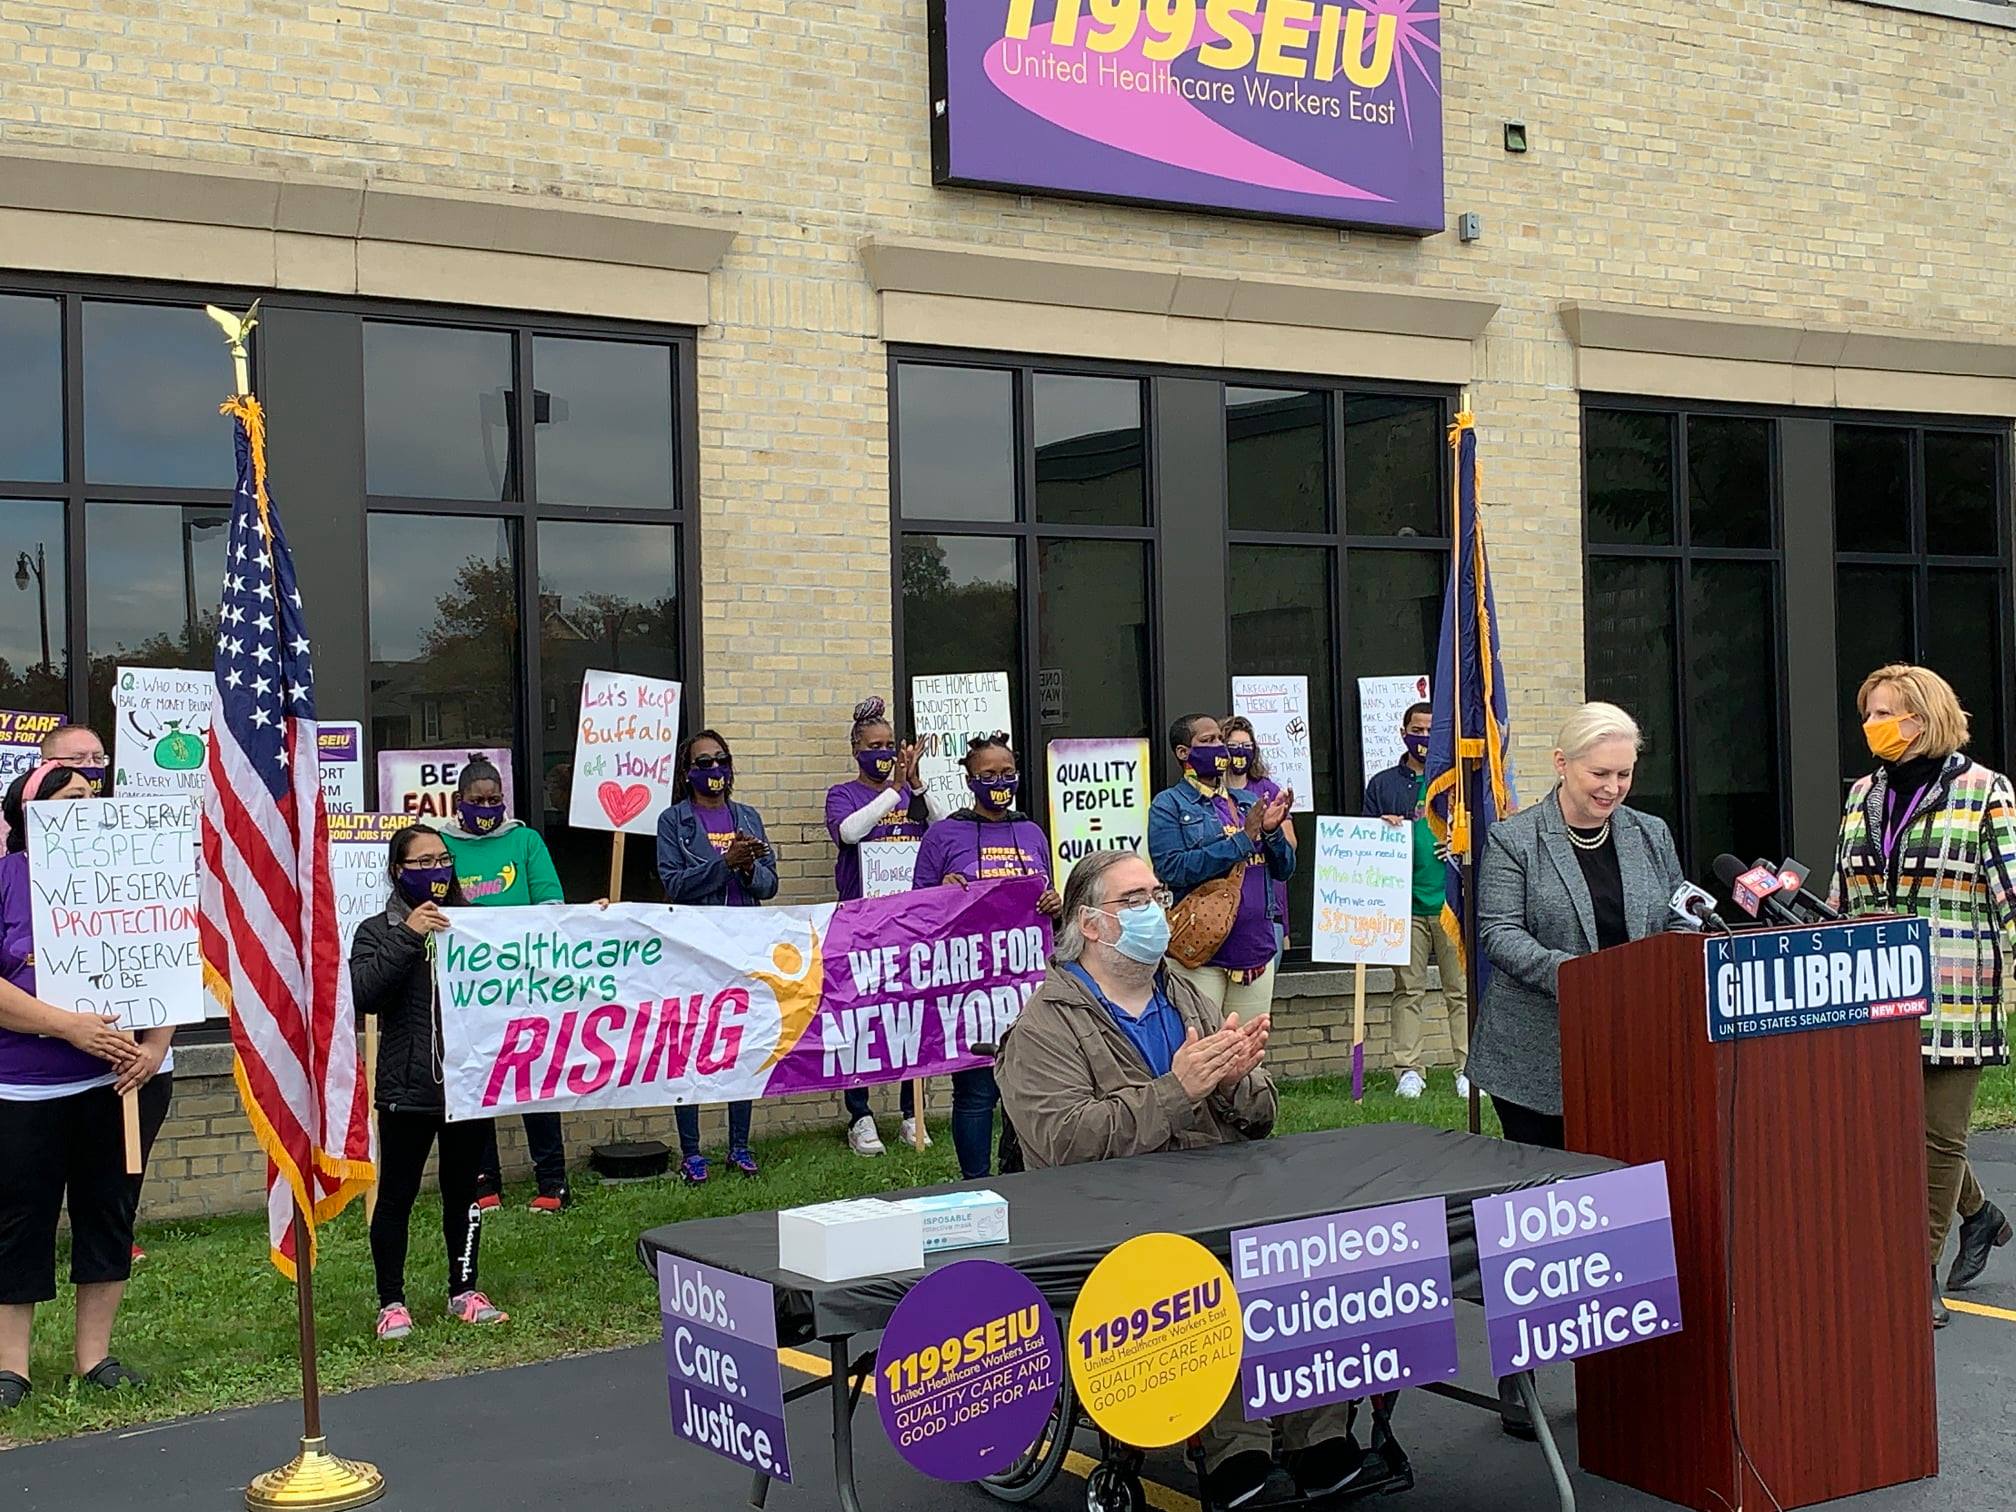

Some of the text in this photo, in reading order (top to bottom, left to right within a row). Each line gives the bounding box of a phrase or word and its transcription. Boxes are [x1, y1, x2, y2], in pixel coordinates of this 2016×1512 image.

[1004, 0, 1397, 89] 1199SEIU
[1002, 42, 1397, 125] United Healthcare Workers East
[143, 677, 169, 693] WHO
[584, 682, 627, 707] Let's
[915, 674, 1001, 694] THE HOMECARE
[1364, 682, 1388, 695] WITH
[189, 700, 211, 711] BELON
[916, 697, 988, 714] INDUSTRY IS
[916, 714, 970, 730] MAJORITY
[14, 732, 35, 743] FOR
[319, 734, 350, 746] SEIU
[582, 714, 672, 744] Buffalo
[137, 772, 171, 787] EVERY
[421, 763, 457, 786] BE
[615, 751, 672, 785] HOME
[1057, 761, 1137, 786] QUALITY
[990, 788, 1012, 802] VOTE
[1063, 788, 1134, 813] PEOPLE
[32, 802, 192, 832] WE DESERVE
[354, 830, 379, 840] JOBS
[1320, 822, 1406, 844] We Are Here
[45, 831, 192, 869] RESPECT
[1321, 844, 1352, 859] When
[1355, 849, 1372, 865] you
[1375, 849, 1395, 858] need
[33, 871, 198, 905] WE DESERVE
[1320, 887, 1350, 906] When
[51, 905, 200, 937] PROTECTION
[42, 941, 200, 975] WE DESERVE
[447, 932, 663, 972] healthcare
[848, 926, 1046, 997] WE CARE FOR
[88, 972, 147, 990] TO BE
[450, 966, 618, 1008] workers
[1717, 944, 1924, 1018] GILLIBRAND
[1719, 1000, 1926, 1036] UNTED STATES SENATOR FOR NEW YORK
[480, 986, 750, 1108] RISING
[822, 999, 924, 1078] NEW
[923, 1213, 972, 1225] ISPOSABLE
[1498, 1191, 1610, 1249] Jobs.
[1238, 1220, 1420, 1280] Empleos.
[1504, 1251, 1625, 1306] Care.
[670, 1264, 736, 1331] Jobs.
[1243, 1276, 1450, 1342] Cuidados.
[1078, 1277, 1221, 1360] 1199SEIU
[1511, 1298, 1669, 1368] Justice.
[884, 1303, 1041, 1394] 1199SEIU
[1084, 1308, 1227, 1373] United Healthcare Workers East
[674, 1326, 747, 1398] Care.
[890, 1335, 1045, 1406] United Healthcare Workers East
[1090, 1326, 1233, 1395] QUALITY CARE AND
[1094, 1344, 1236, 1412] GOOD JOBS FOR ALL
[1249, 1343, 1412, 1409] Justicia.
[896, 1355, 1051, 1429] QUALITY CARE AND
[900, 1373, 1054, 1447] GOOD JOBS FOR ALL
[682, 1388, 781, 1475] Justice.
